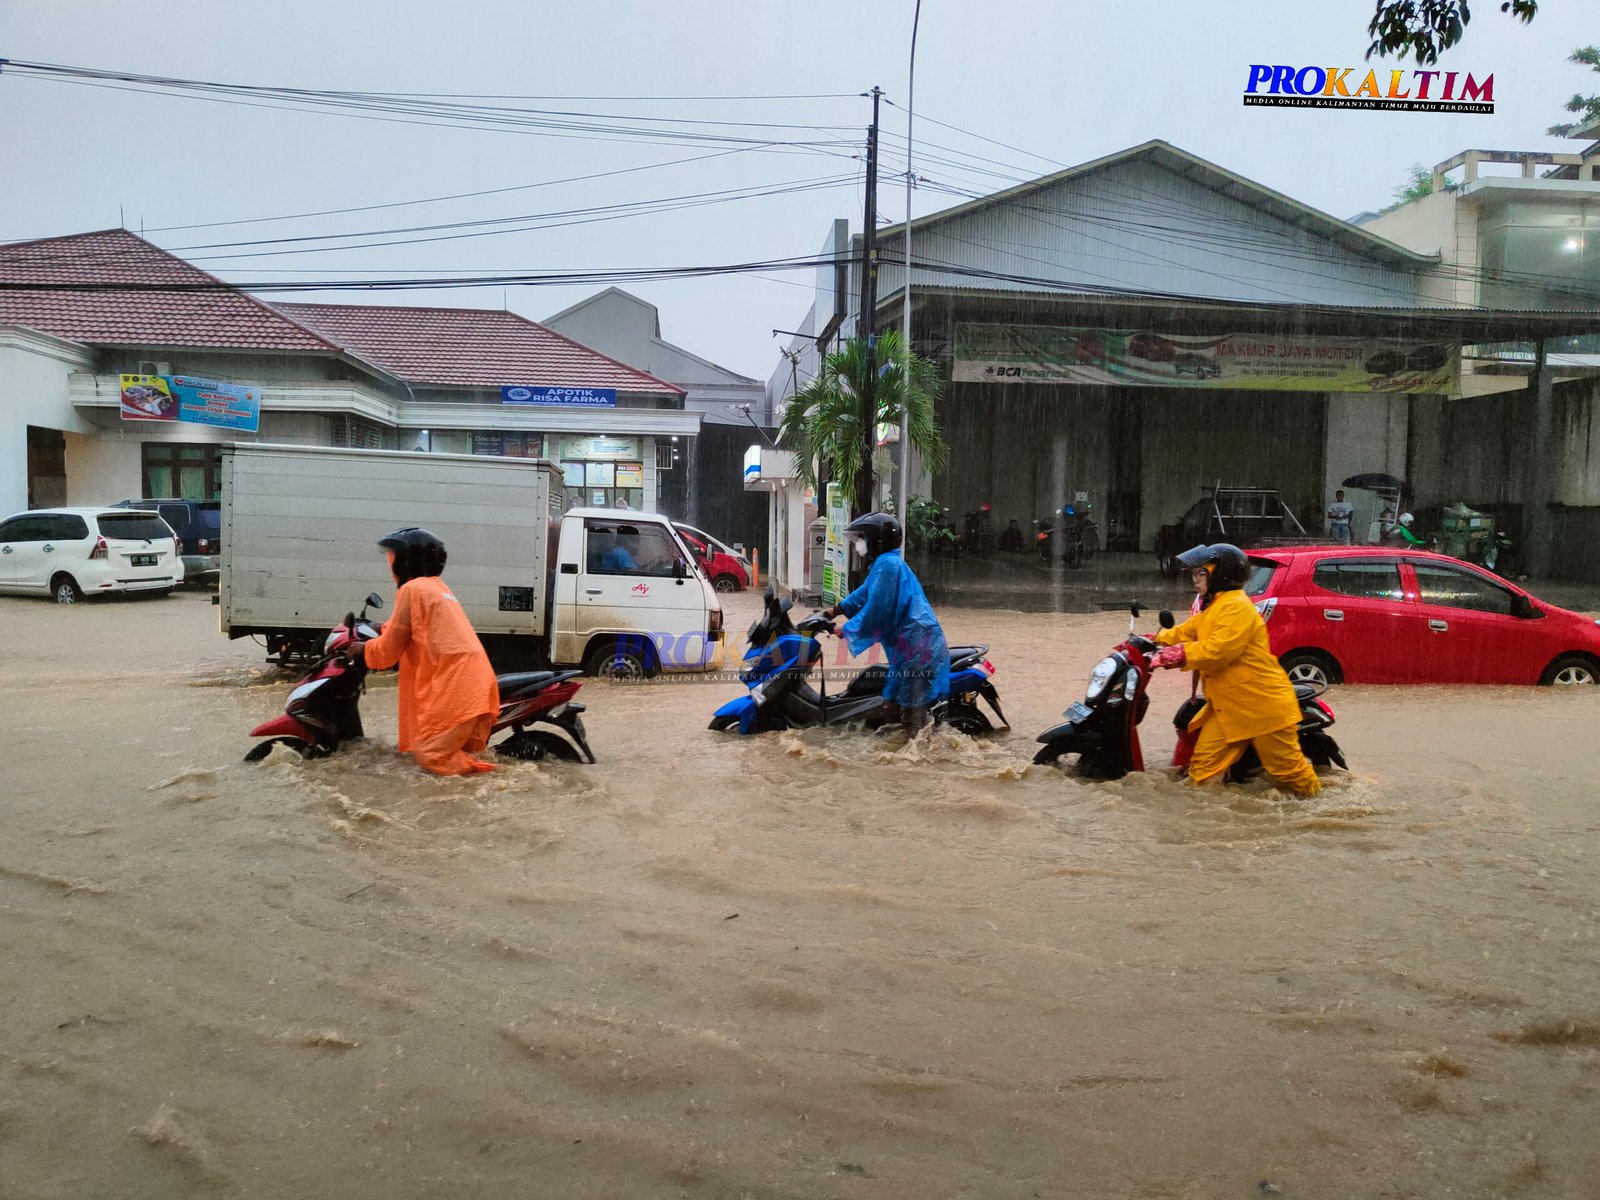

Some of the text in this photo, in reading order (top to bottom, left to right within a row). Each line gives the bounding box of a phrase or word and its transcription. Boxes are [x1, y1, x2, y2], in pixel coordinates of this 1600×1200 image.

[1215, 343, 1364, 360] MAKMUR JAYA MOTOR
[996, 367, 1022, 377] BCA
[547, 388, 594, 397] APOTIK
